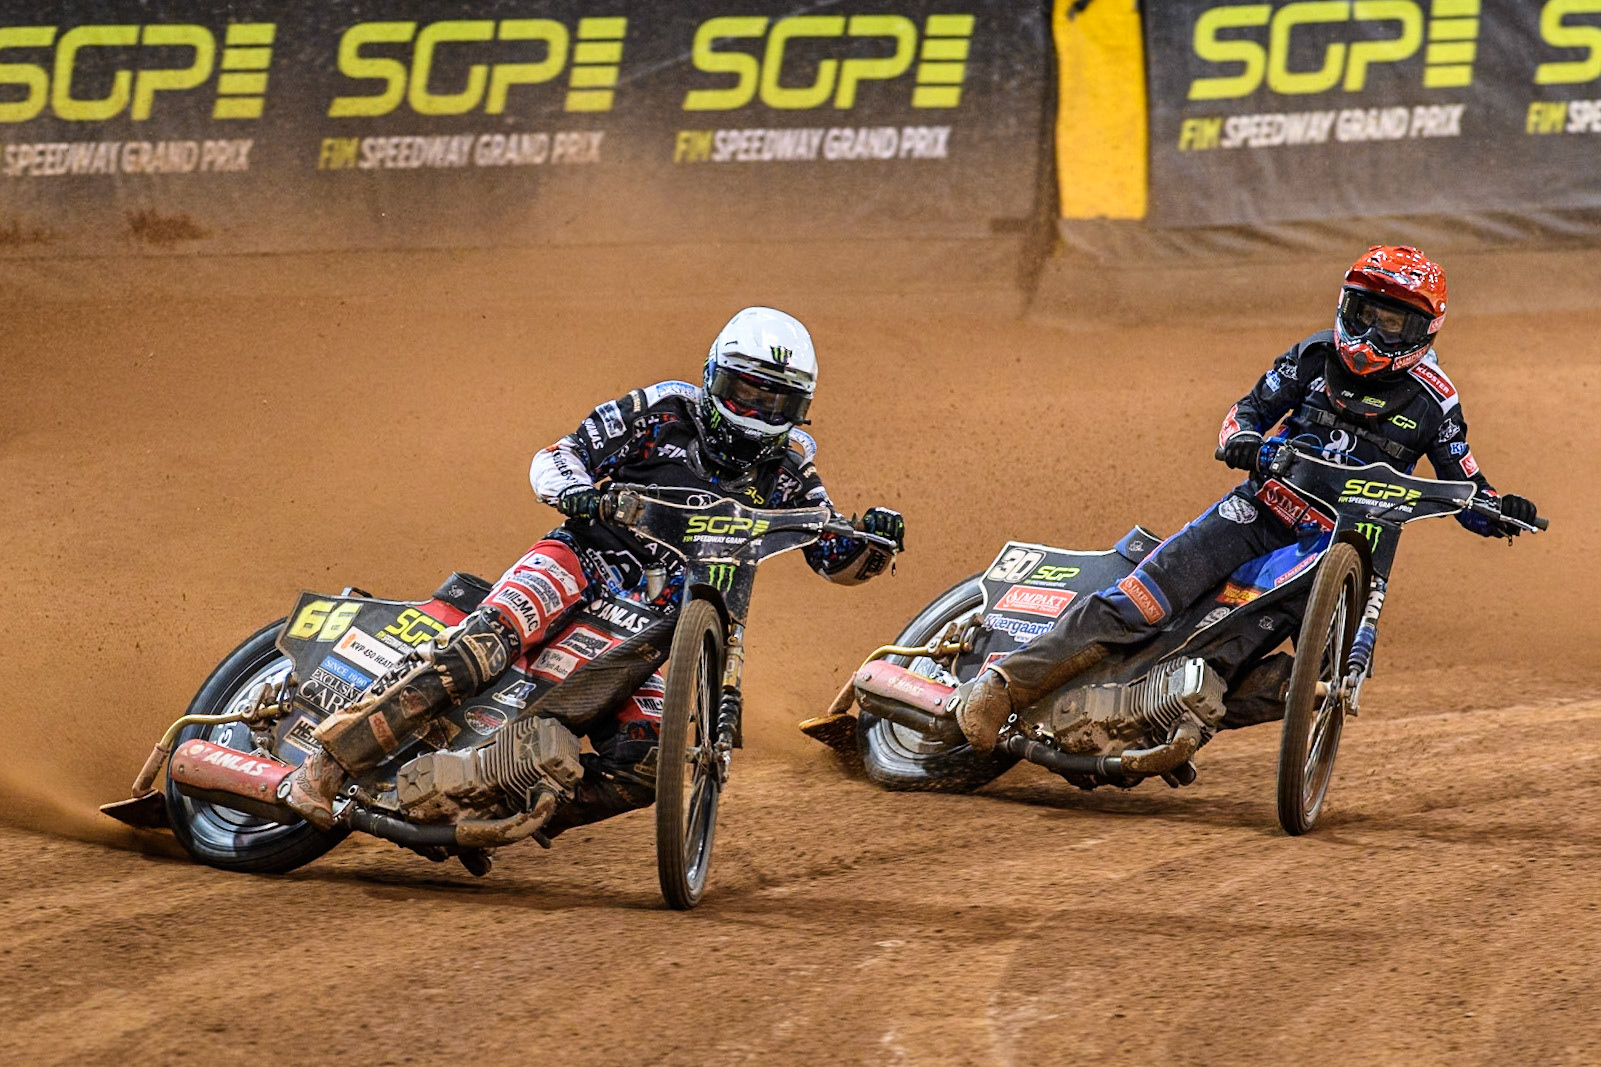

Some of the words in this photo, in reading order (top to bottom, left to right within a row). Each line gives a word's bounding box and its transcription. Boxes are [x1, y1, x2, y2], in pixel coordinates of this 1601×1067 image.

[681, 15, 918, 111] SGP
[1187, 0, 1424, 100] SGP
[328, 19, 569, 117] SGP
[1179, 118, 1222, 151] FIM
[1221, 111, 1335, 148] SPEEDWAY
[1335, 107, 1409, 142] GRAND
[1409, 104, 1465, 137] PRIX
[1526, 101, 1567, 134] FIM
[2, 141, 121, 177] SPEEDWAY
[120, 140, 199, 174] GRAND
[199, 139, 254, 171] PRIX
[318, 137, 359, 170] FIM
[359, 135, 475, 169] SPEEDWAY
[473, 132, 550, 167] GRAND
[550, 131, 606, 166] PRIX
[674, 131, 713, 163] FIM
[712, 128, 825, 162] SPEEDWAY
[823, 127, 900, 160] GRAND
[898, 125, 952, 158] PRIX
[1416, 365, 1450, 394] KLOSTER
[1387, 414, 1417, 430] GP
[1341, 479, 1407, 500] SGP
[1348, 496, 1380, 507] SPEEDWAY
[1400, 505, 1413, 514] PRIX
[685, 515, 754, 534] SGP
[694, 534, 726, 544] SPEEDWAY
[987, 547, 1047, 583] 30
[1031, 565, 1080, 581] SGP
[286, 600, 364, 643] 66
[597, 602, 650, 633] ANLAS
[350, 641, 365, 653] KVP
[364, 648, 375, 659] 450
[311, 668, 361, 701] EXCLUSIV
[324, 659, 347, 677] SINCE
[348, 672, 368, 687] 1990
[203, 749, 271, 776] ANLAS
